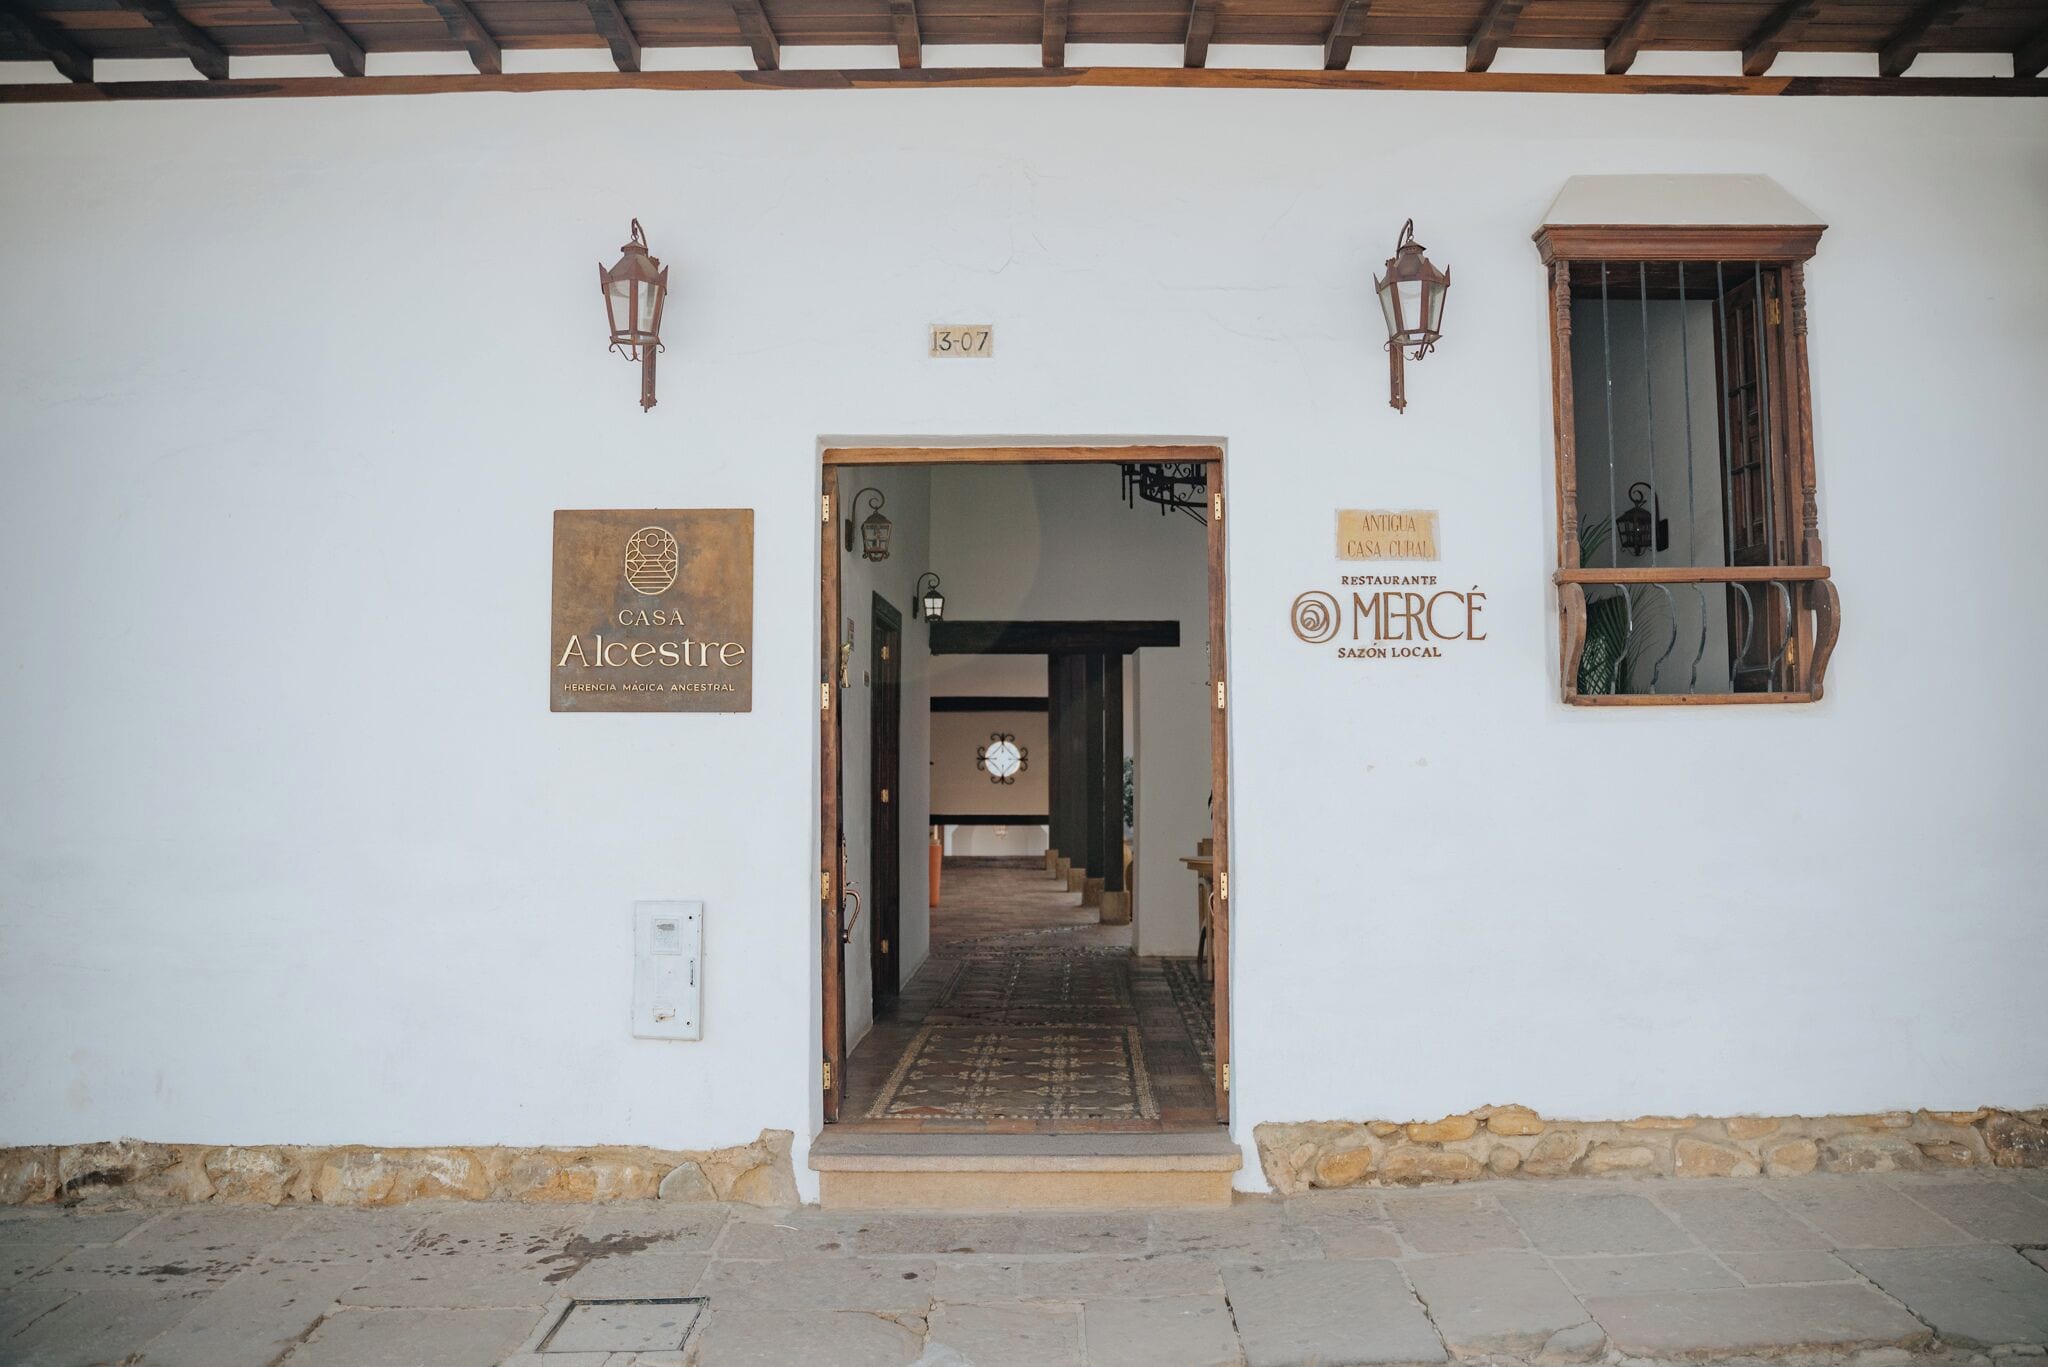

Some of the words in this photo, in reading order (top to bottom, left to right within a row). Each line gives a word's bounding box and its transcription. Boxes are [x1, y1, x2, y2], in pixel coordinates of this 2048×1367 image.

[932, 331, 988, 351] 13-07
[1362, 514, 1416, 532] ANTIGUA
[1347, 540, 1382, 558] CASA
[1341, 575, 1437, 585] RESTAURANTE
[619, 609, 685, 626] CASA
[1353, 584, 1487, 641] MERCÉ
[556, 634, 745, 667] Alcestre
[1338, 642, 1387, 658] SAZÓN
[1391, 647, 1442, 658] LOCAL
[564, 682, 617, 692] HERENCIA
[622, 680, 664, 692] MÁGICA
[670, 682, 736, 692] ANCESTRAL
